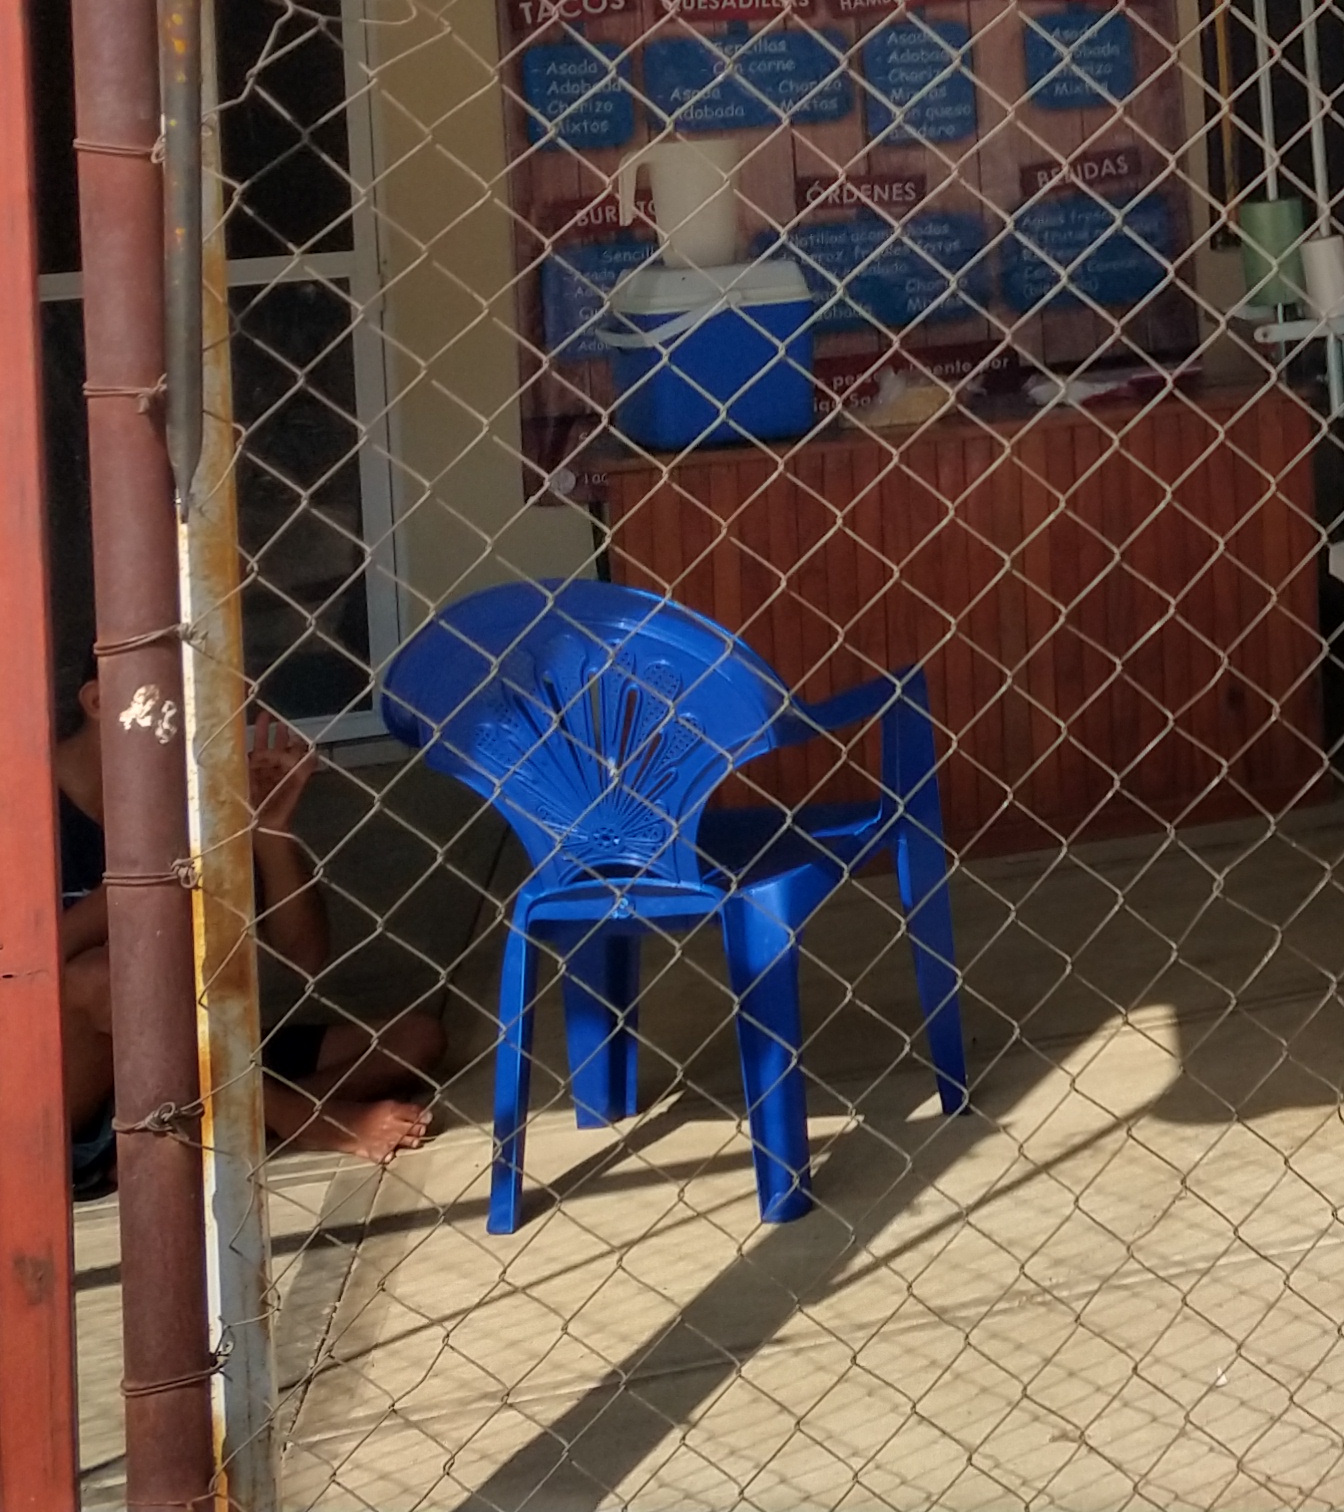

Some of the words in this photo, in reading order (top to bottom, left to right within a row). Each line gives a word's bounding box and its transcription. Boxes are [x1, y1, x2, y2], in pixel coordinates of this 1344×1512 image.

[887, 32, 936, 46] Asad
[546, 60, 599, 77] Asada
[749, 59, 795, 73] carne
[805, 178, 917, 205] ÓRDENES
